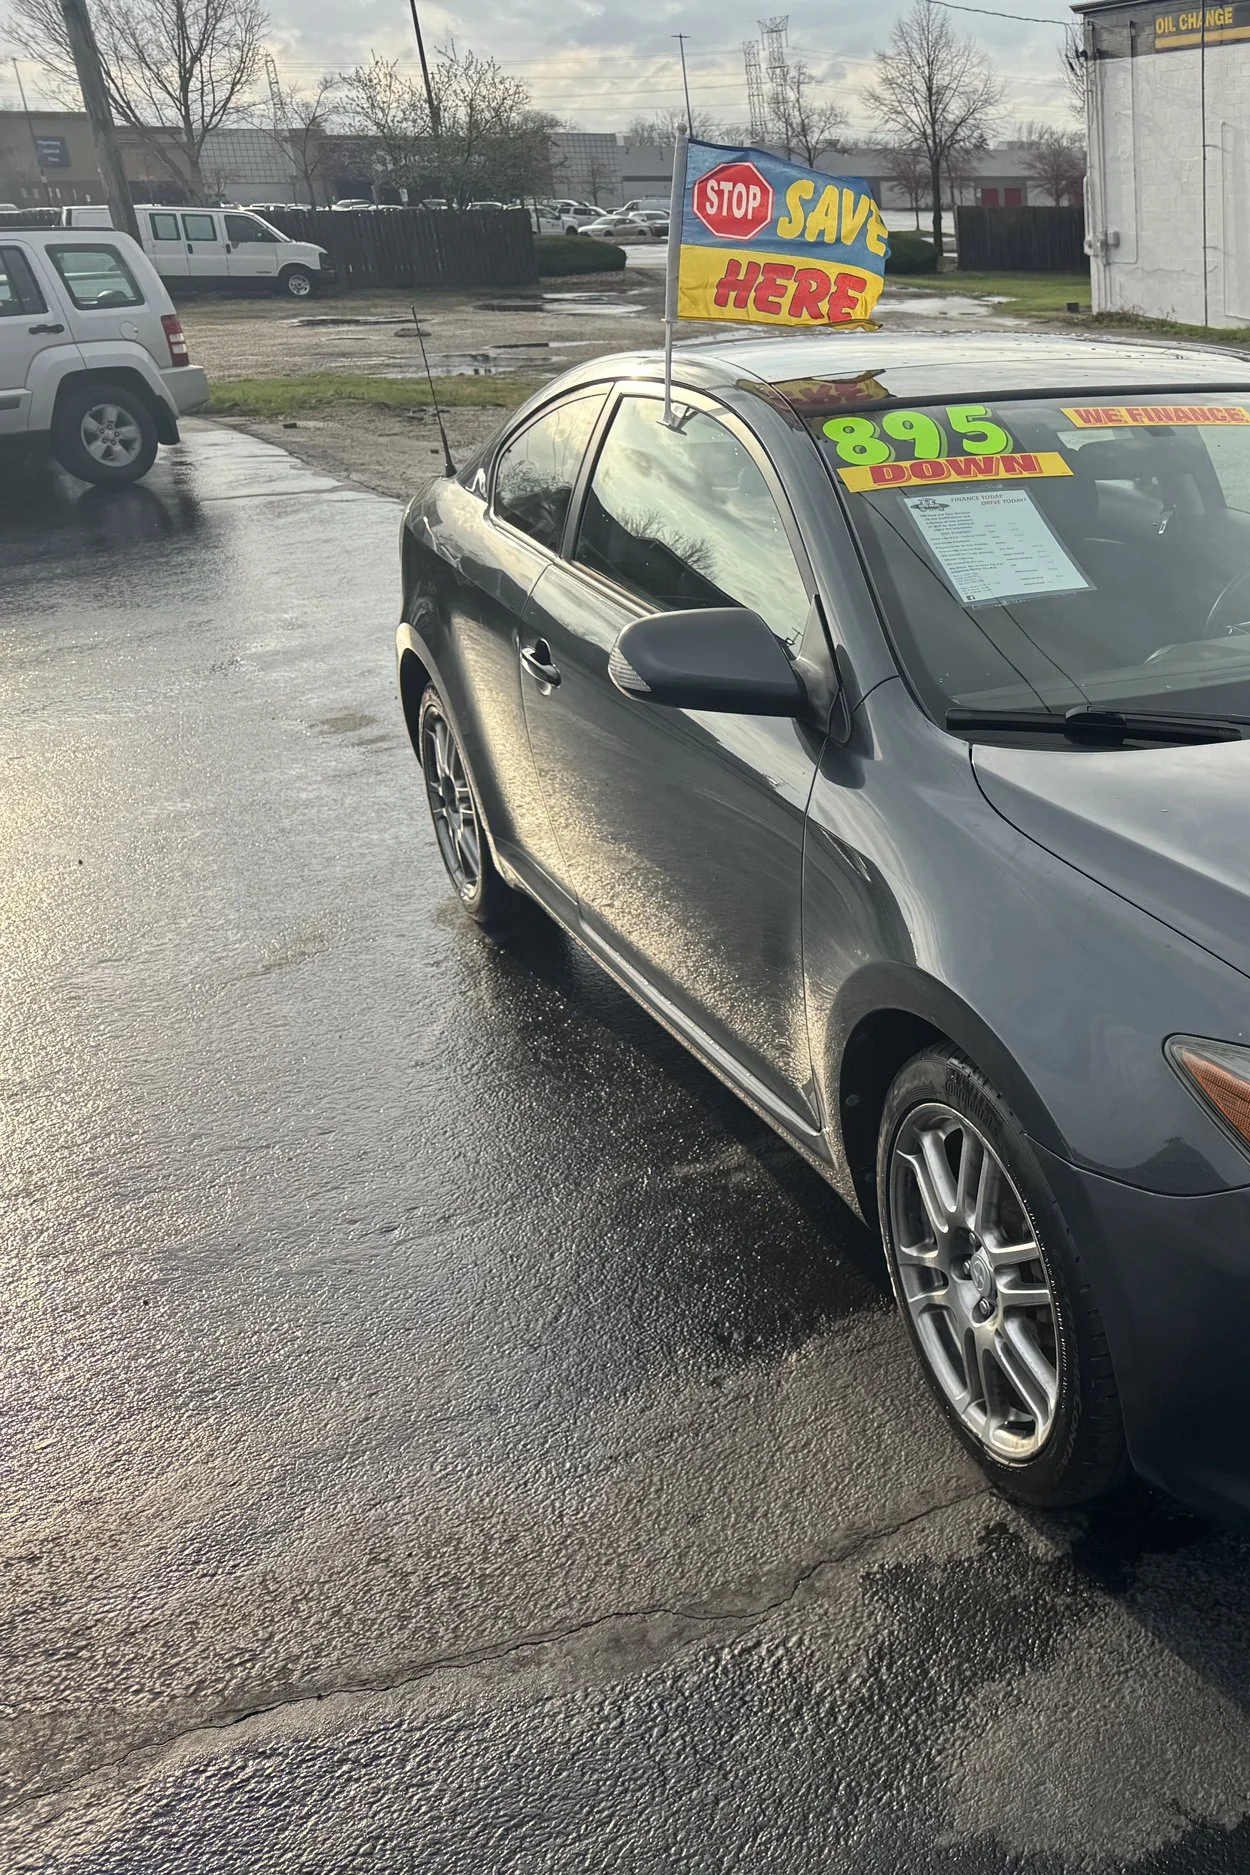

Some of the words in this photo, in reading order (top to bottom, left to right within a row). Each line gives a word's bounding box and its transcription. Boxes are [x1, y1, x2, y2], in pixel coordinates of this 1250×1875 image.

[1156, 16, 1176, 34] OIL
[1179, 7, 1233, 31] CHANGE
[705, 179, 761, 219] STOP
[776, 178, 889, 257] SAVE
[714, 258, 868, 324] HERE
[821, 404, 1014, 466] 895
[1073, 406, 1124, 425] WE
[1125, 405, 1247, 426] FINANCE
[870, 454, 1041, 485] DOWN
